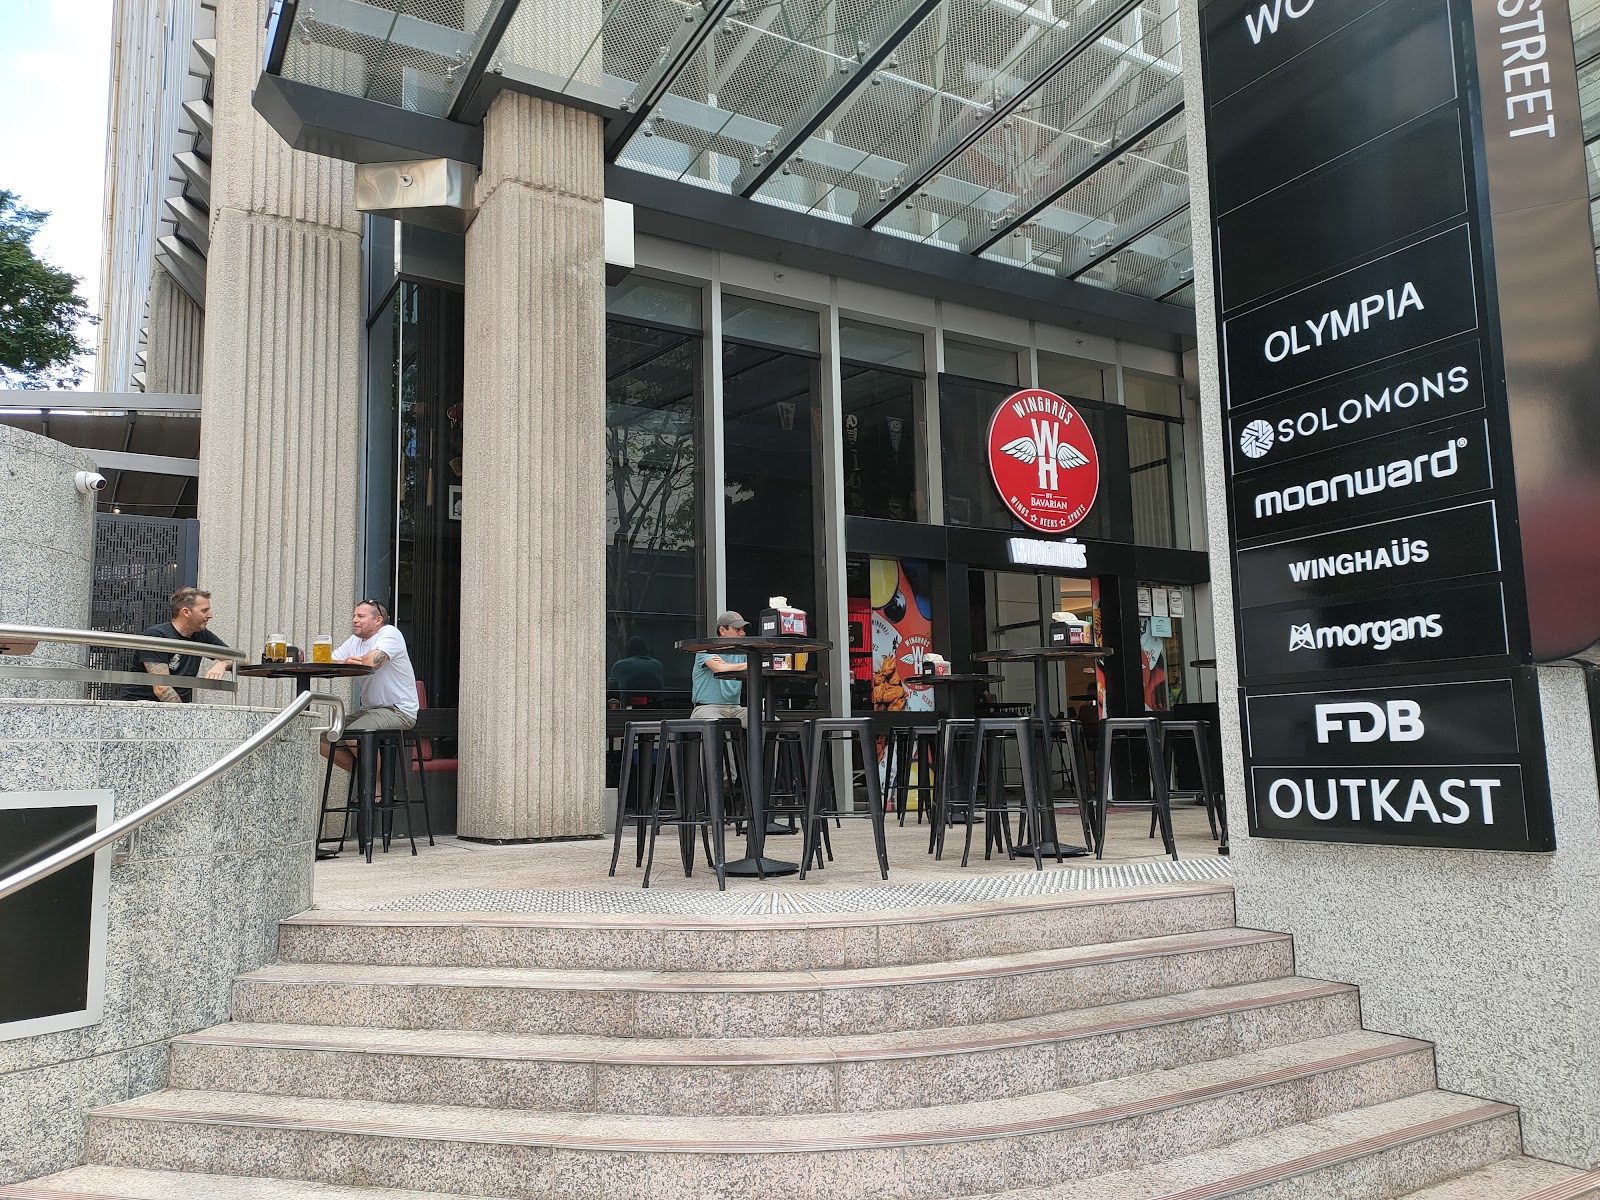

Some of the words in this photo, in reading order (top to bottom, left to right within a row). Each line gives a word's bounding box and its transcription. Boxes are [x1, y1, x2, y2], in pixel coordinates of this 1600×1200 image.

[1497, 0, 1556, 137] STREET
[1264, 281, 1425, 363] OLYMPIA
[1012, 397, 1073, 425] WINGHAÜS
[1277, 366, 1469, 443] SOLOMONS
[1010, 495, 1029, 517] WINGS
[1040, 517, 1058, 528] BEERS
[1067, 504, 1086, 523] SPORTS
[1031, 497, 1068, 509] BAVARIAN
[1288, 537, 1430, 583] WINGHAÜS
[1316, 613, 1443, 651] morgans
[1315, 699, 1425, 744] FDB
[1268, 778, 1501, 825] OUTKAST
